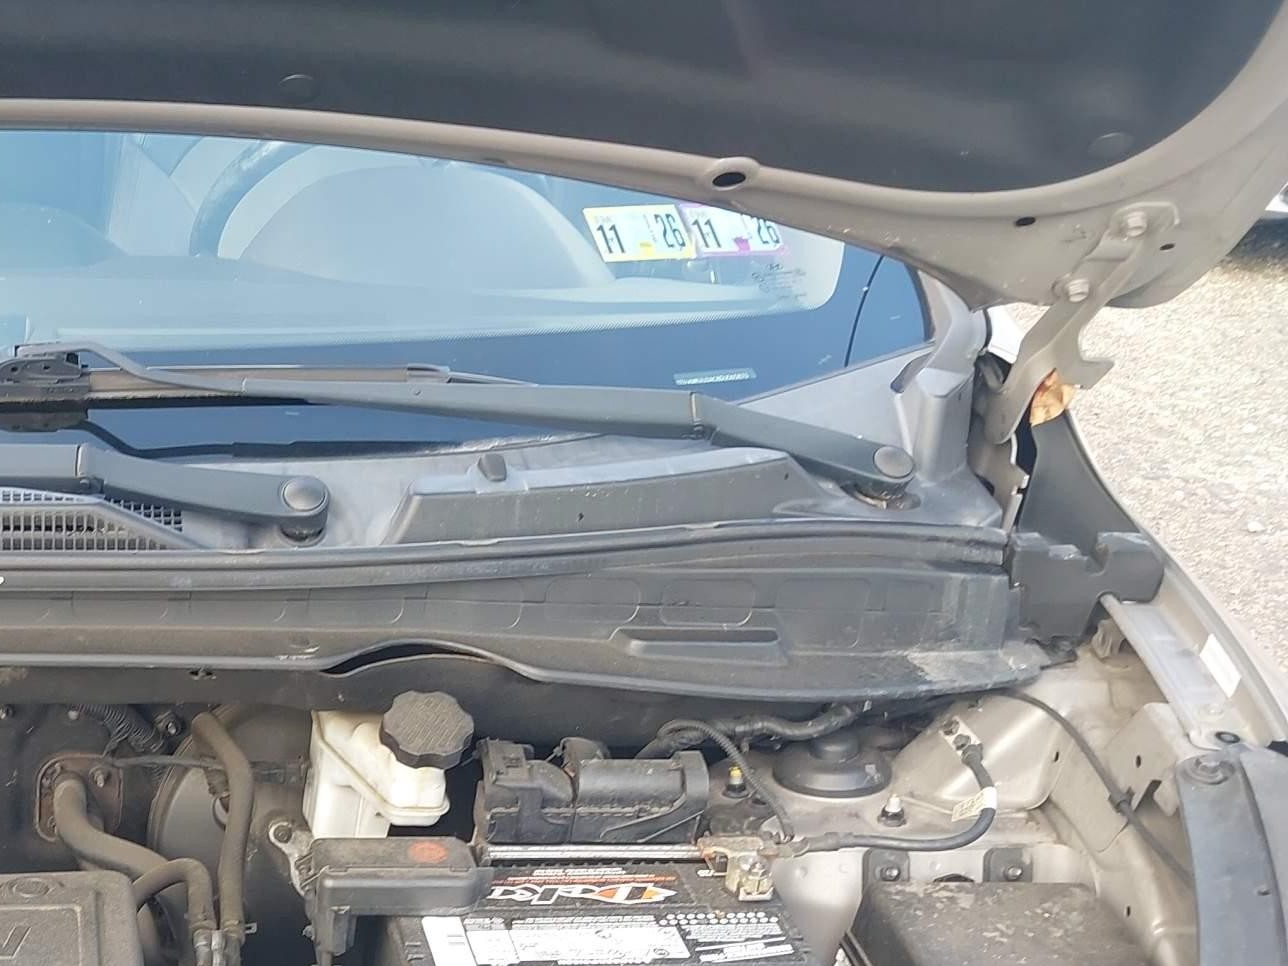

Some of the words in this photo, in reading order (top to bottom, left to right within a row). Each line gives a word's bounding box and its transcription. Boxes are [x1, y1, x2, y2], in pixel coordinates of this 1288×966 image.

[596, 224, 625, 254] 11
[654, 213, 686, 249] 26
[691, 218, 722, 249] 11
